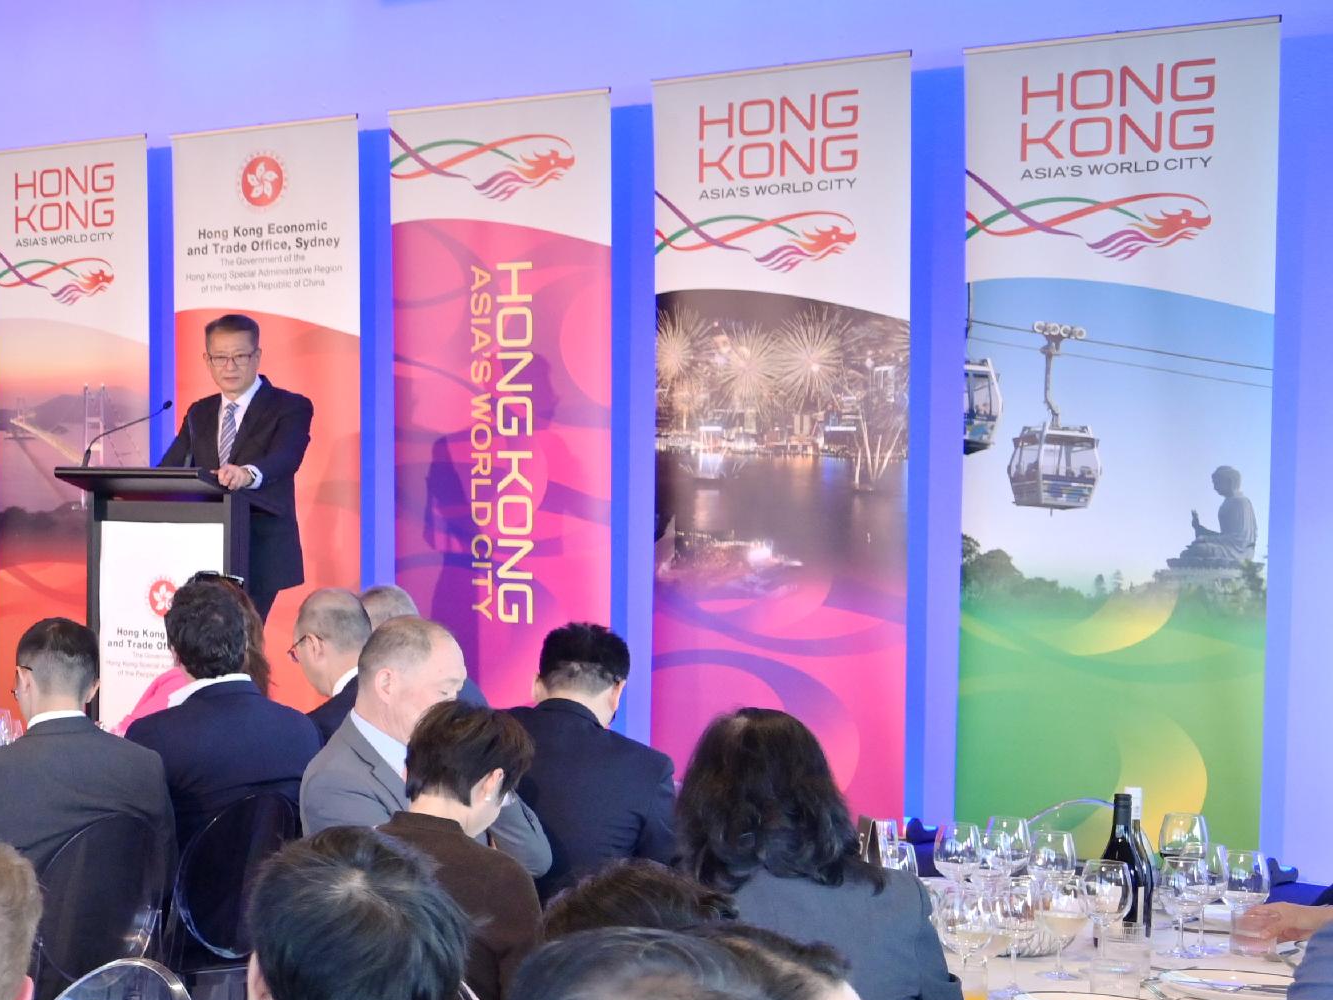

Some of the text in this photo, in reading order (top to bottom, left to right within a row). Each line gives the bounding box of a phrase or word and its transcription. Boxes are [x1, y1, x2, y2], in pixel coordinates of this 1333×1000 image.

[1022, 58, 1216, 115] HONG
[698, 89, 859, 141] HONG
[1020, 106, 1215, 162] KONG
[698, 133, 858, 184] KONG
[1021, 156, 1213, 181] ASIA'S WORLD CITY
[14, 162, 115, 200] HONG
[699, 177, 857, 202] ASIA'S WORLD CITY
[14, 197, 115, 234] KONG
[198, 219, 328, 241] Hong Kong Economic
[15, 231, 114, 248] ASIA'S WORLD CITY
[187, 235, 340, 256] and Trade Office, Sydney
[470, 264, 493, 620] ASIA'S WORLD CITY
[496, 261, 534, 626] HONG KONG
[108, 639, 124, 648] and
[127, 640, 153, 650] Trade
[117, 628, 165, 639] Hong Kong
